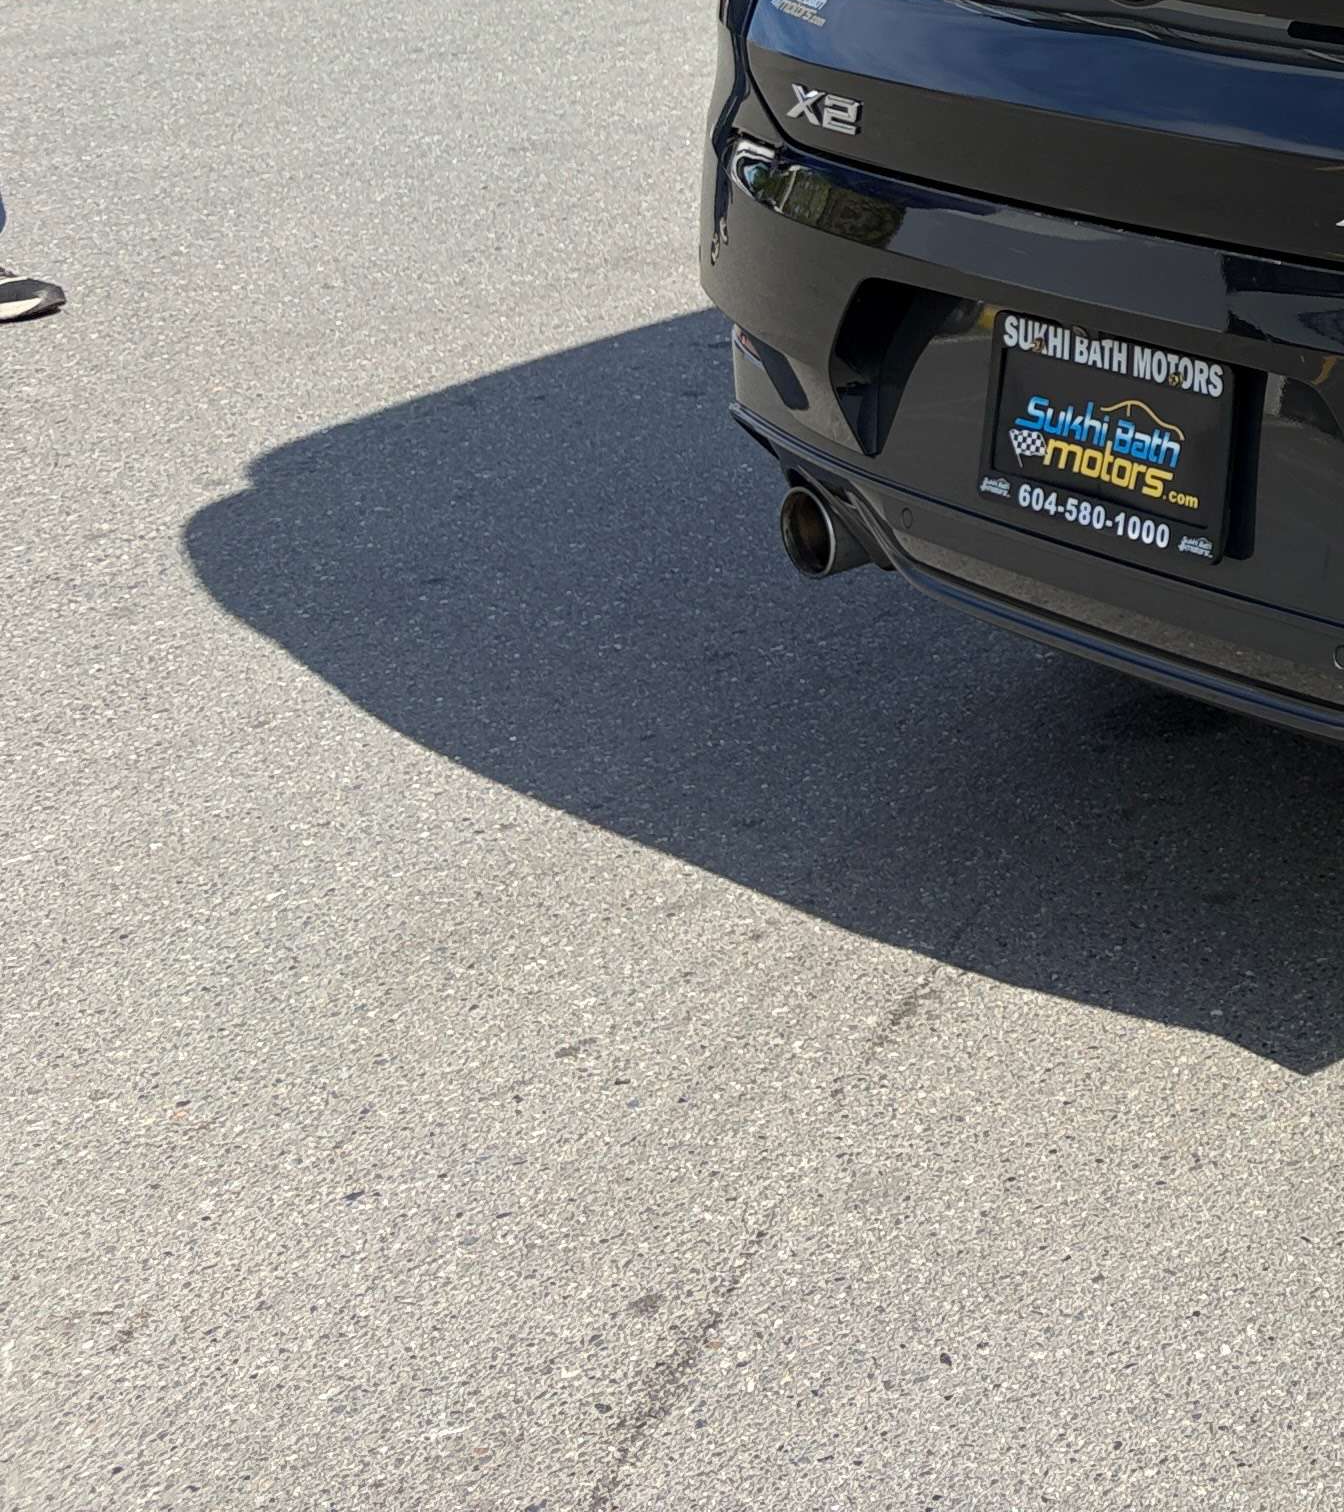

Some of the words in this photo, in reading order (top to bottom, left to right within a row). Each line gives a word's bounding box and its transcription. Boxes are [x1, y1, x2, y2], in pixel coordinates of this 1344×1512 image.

[786, 83, 860, 136] X2
[1003, 315, 1071, 361] SUKHI
[1074, 335, 1128, 375] BATH
[1133, 345, 1224, 398] MOTORS
[1014, 395, 1110, 447] Sukhi
[1113, 419, 1181, 469] Bath
[1018, 484, 1170, 549] 604-580-1000
